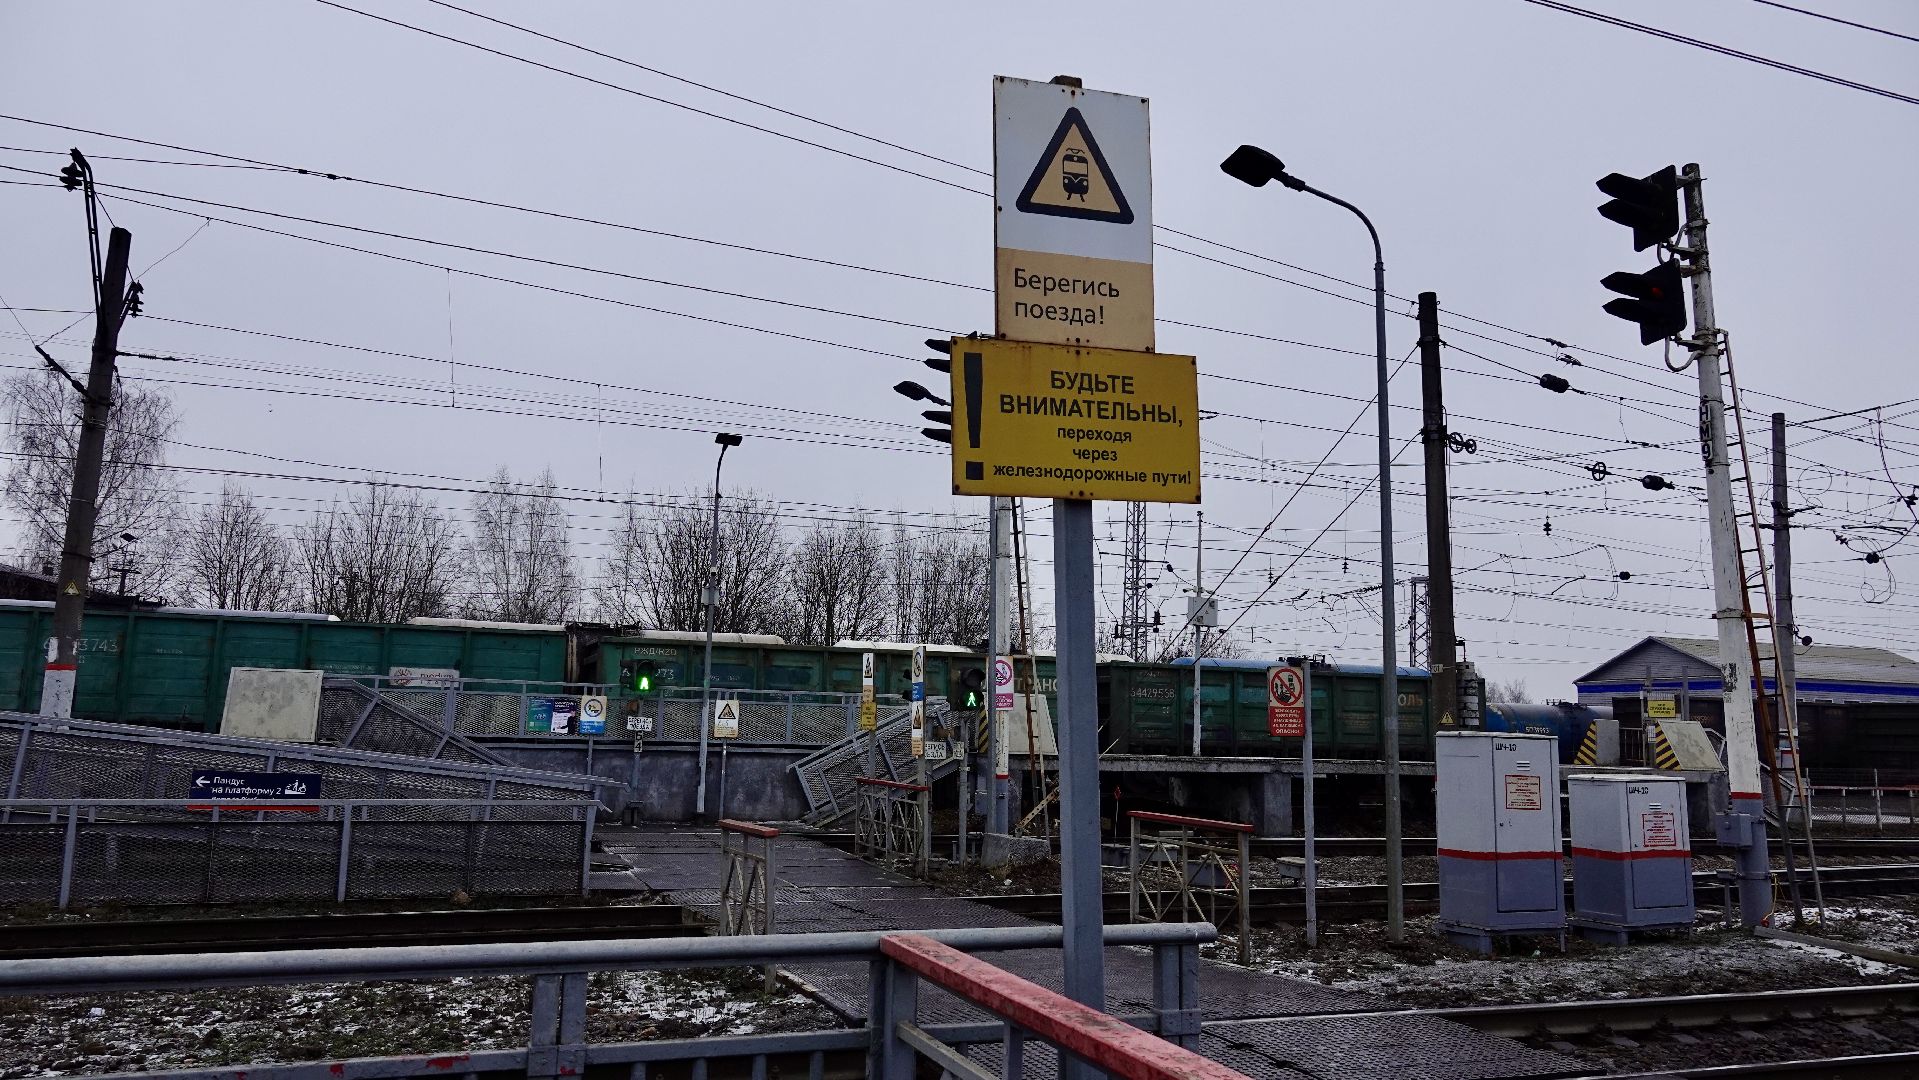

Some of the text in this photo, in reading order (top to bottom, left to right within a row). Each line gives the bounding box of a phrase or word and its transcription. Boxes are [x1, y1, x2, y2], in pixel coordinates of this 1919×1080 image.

[1014, 267, 1120, 298] Берегись
[1015, 302, 1104, 326] поезда!
[1051, 370, 1135, 394] БУДЬТЕ
[1000, 393, 1183, 427] ВНИМАТЕЛЬНЫ,
[1057, 426, 1132, 444] переходя
[1073, 448, 1118, 463] через
[993, 464, 1191, 486] железнодорожные пути!
[213, 776, 245, 786] Пандус
[225, 786, 274, 796] платформу
[276, 787, 282, 795] 2
